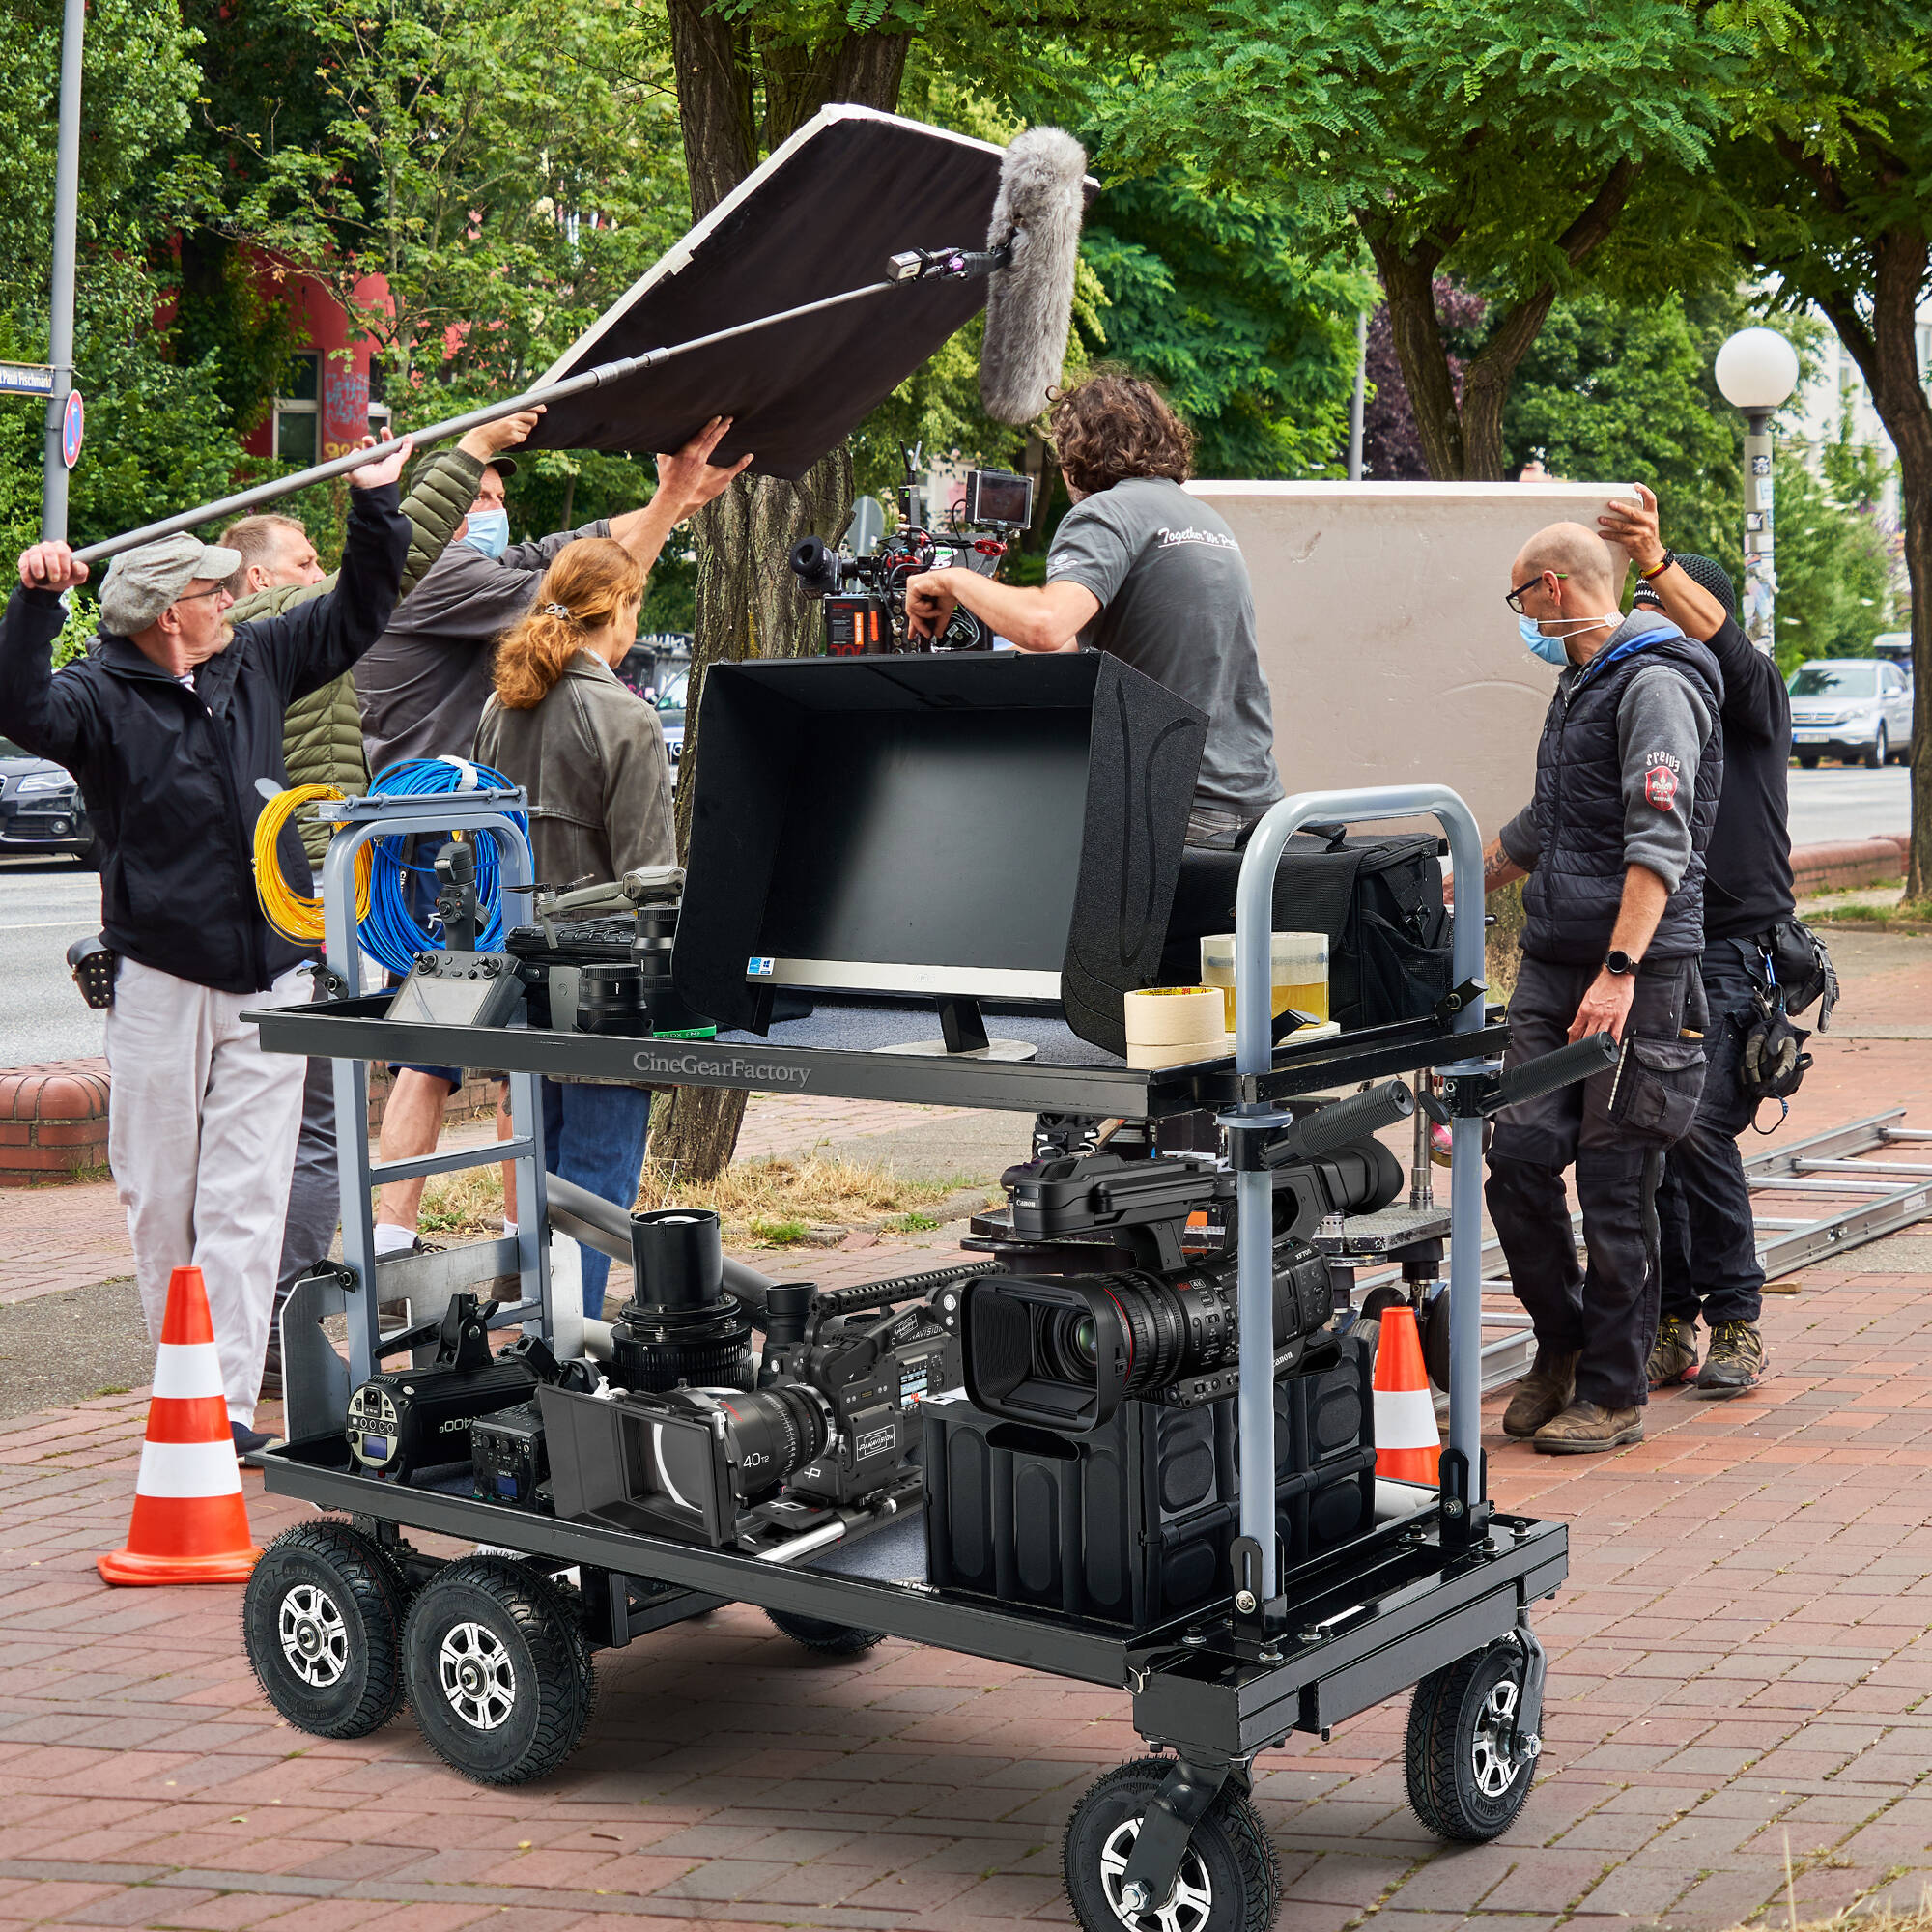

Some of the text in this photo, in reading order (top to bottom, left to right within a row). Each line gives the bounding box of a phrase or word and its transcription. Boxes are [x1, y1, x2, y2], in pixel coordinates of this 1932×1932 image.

[1158, 526, 1204, 545] Together
[633, 1053, 811, 1088] CineGearFactory
[1015, 1199, 1036, 1208] Canon
